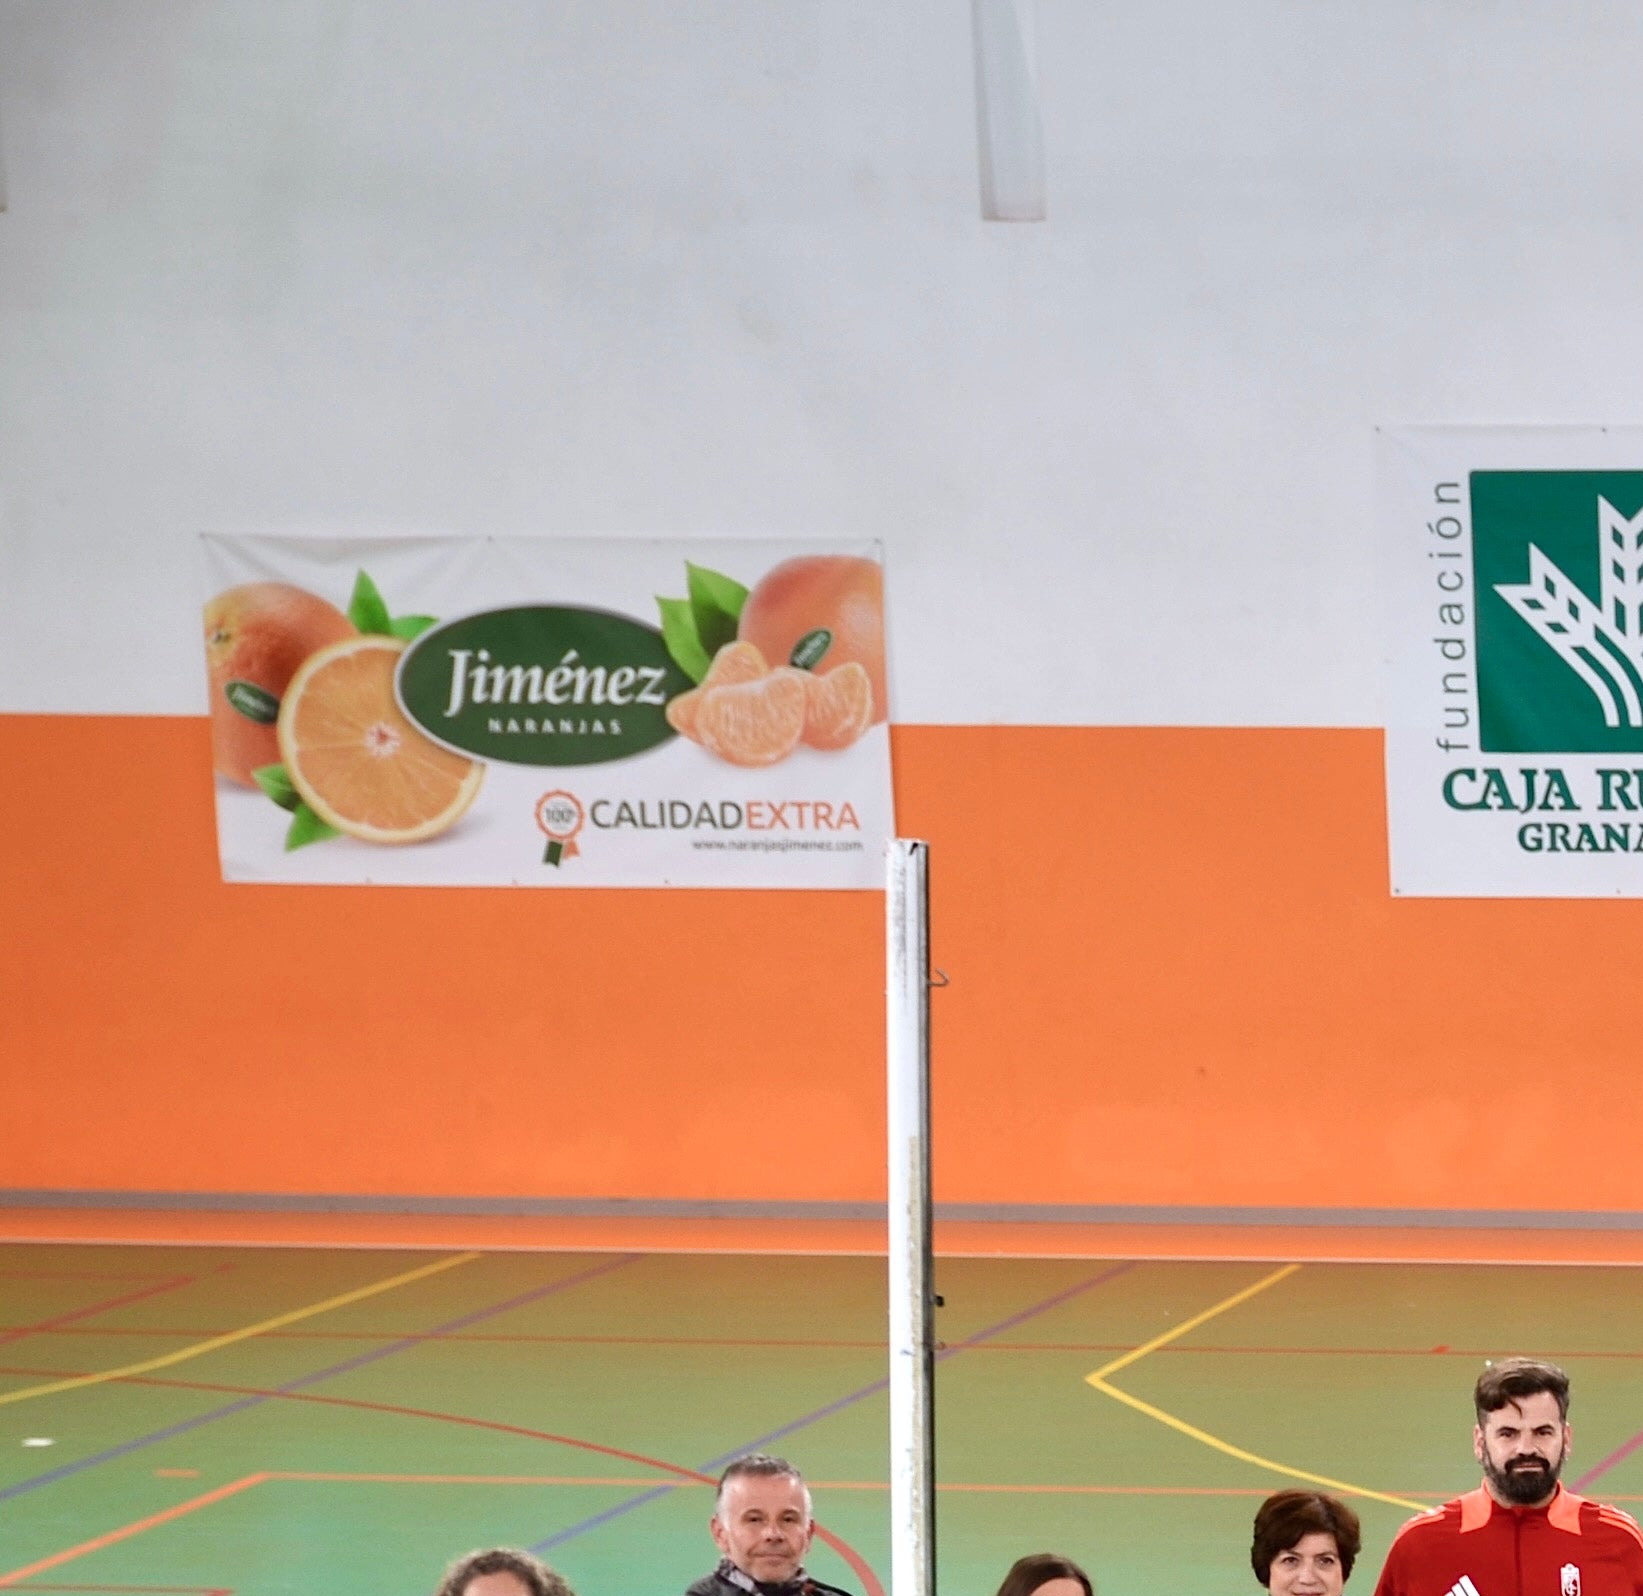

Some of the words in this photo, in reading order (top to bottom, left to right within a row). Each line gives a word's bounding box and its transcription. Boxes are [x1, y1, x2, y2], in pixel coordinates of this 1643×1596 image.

[1428, 480, 1470, 752] fundación
[443, 648, 668, 718] Jiménez
[487, 717, 622, 735] NARANJAS
[1442, 768, 1581, 814] CAJA
[589, 800, 862, 831] CALIDADEXTRA
